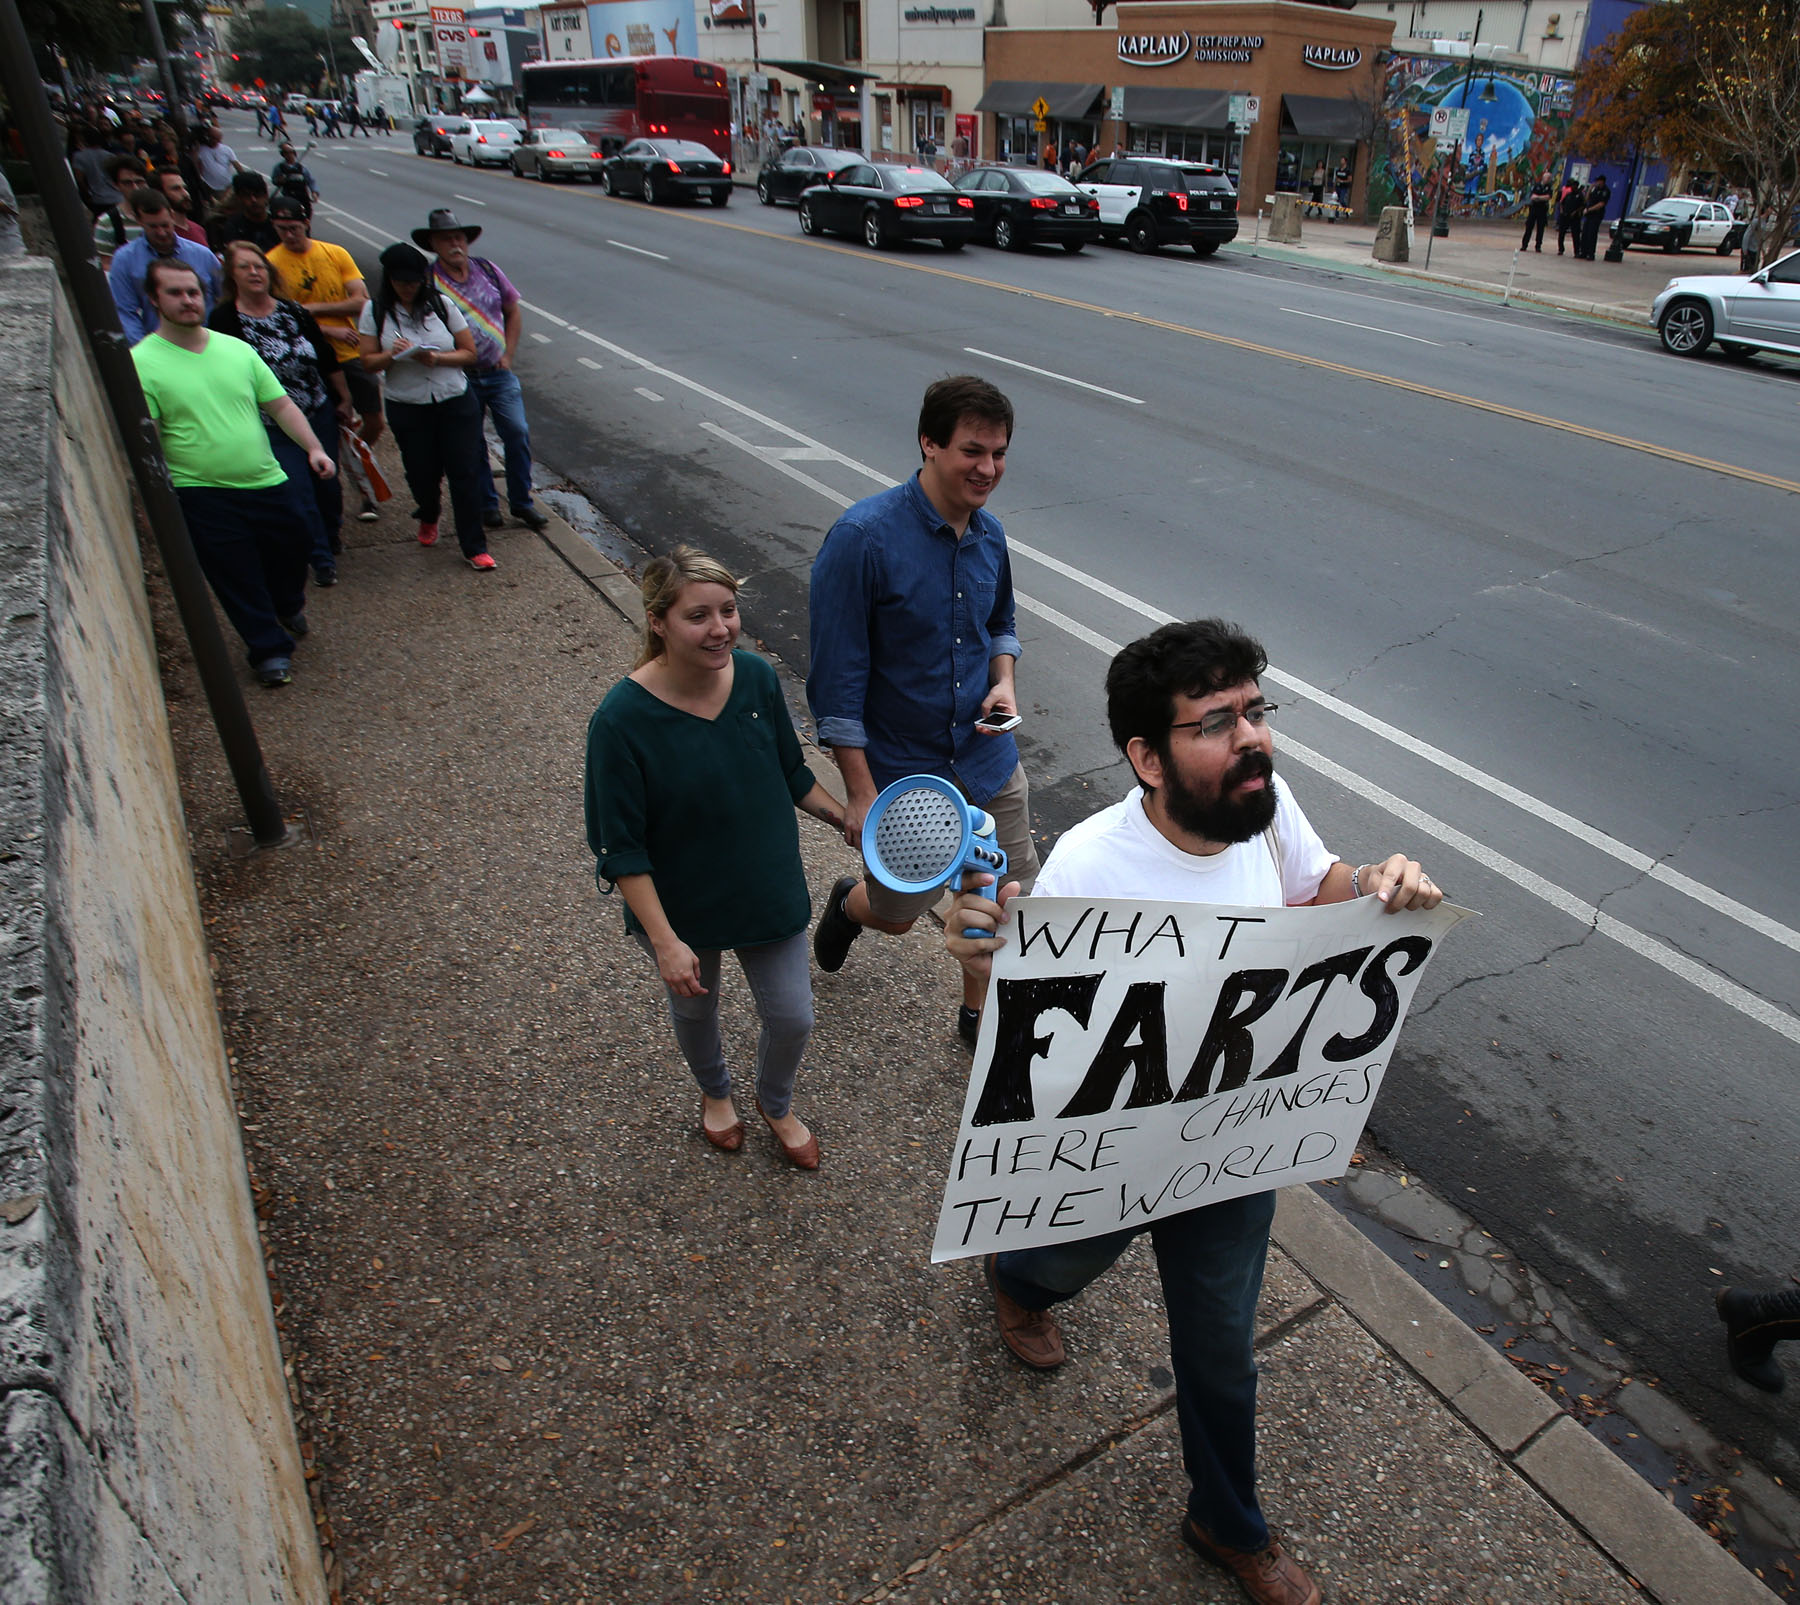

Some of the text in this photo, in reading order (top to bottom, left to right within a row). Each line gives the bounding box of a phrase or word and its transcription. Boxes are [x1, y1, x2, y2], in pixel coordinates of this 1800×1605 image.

[433, 9, 464, 24] TEXAS
[437, 29, 467, 42] CVS
[1117, 35, 1180, 55] KAPLAN
[1195, 35, 1263, 49] TEST PREP AND
[1193, 49, 1251, 63] ADMISSIONS
[1305, 44, 1355, 63] KAPLAN
[1017, 906, 1266, 961] WHAT
[970, 935, 1433, 1128] FARTS
[957, 1063, 1383, 1182] HERE CHANGES
[952, 1131, 1338, 1246] THE WORLD
